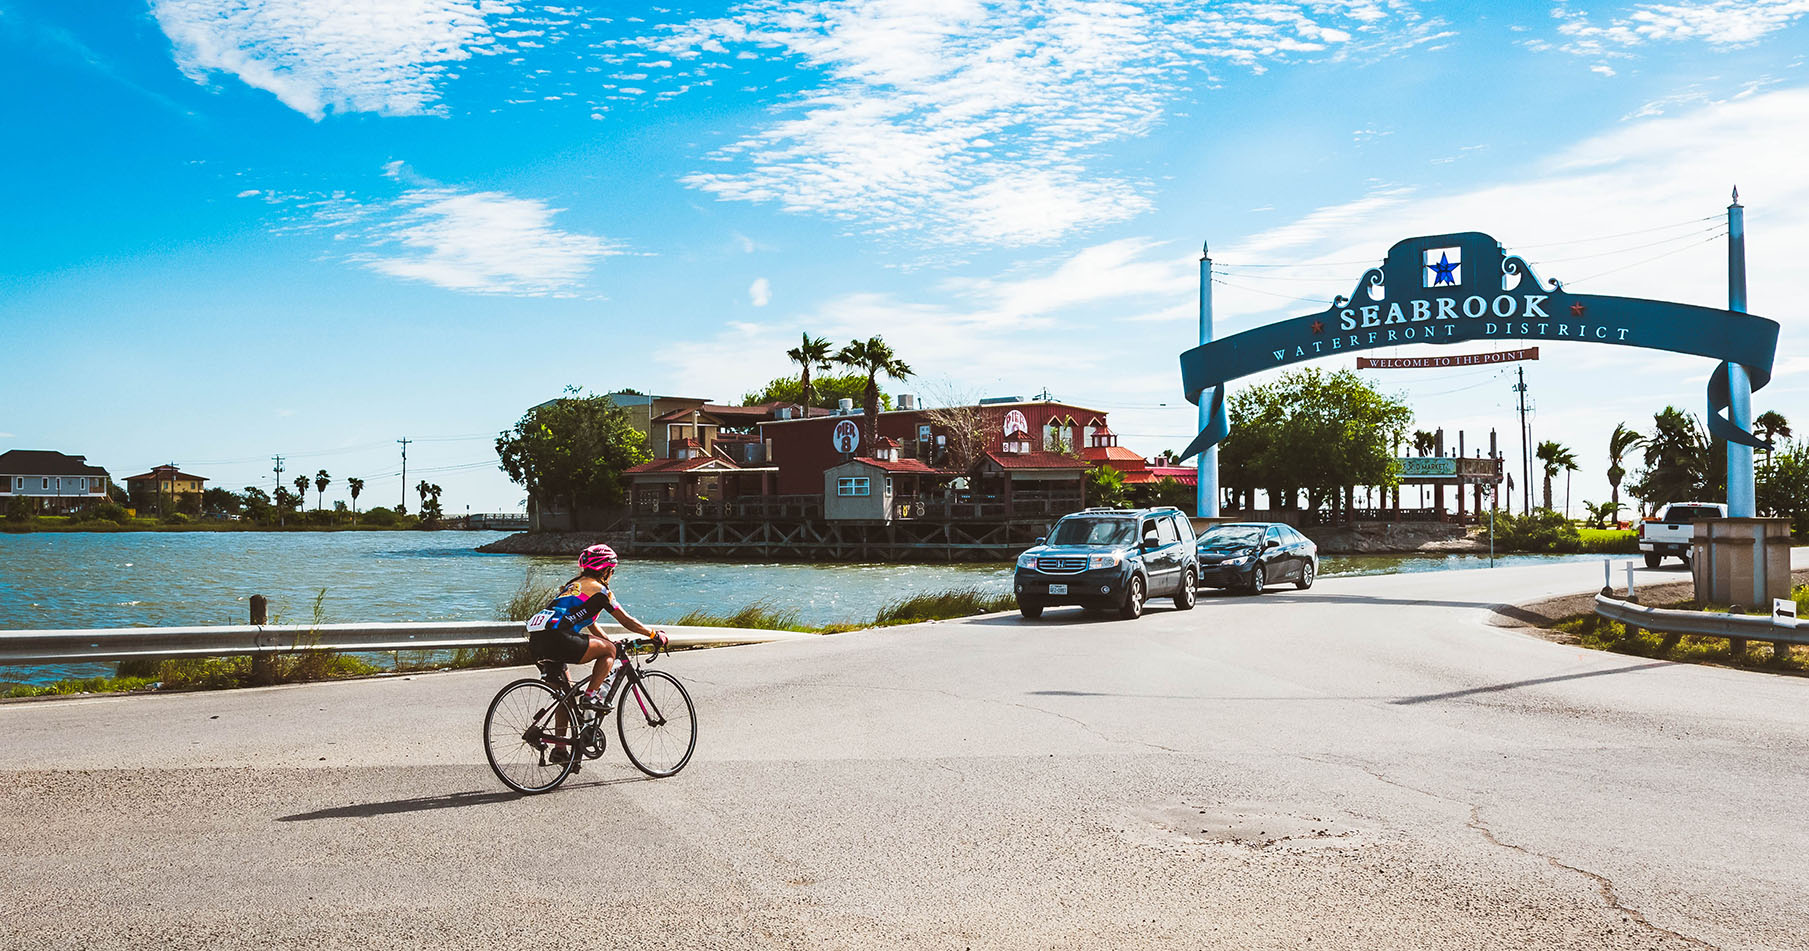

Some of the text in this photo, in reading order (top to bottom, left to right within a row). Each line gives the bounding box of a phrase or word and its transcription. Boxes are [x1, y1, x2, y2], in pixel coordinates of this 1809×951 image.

[1340, 294, 1549, 331] SEABROOK
[1273, 322, 1629, 360] WATERFRONT DISTRICT
[1369, 350, 1525, 368] WELCOME TO THE POINT
[1006, 411, 1026, 429] PIER
[837, 422, 856, 439] PIER
[841, 436, 852, 452] 8
[530, 615, 545, 627] 113
